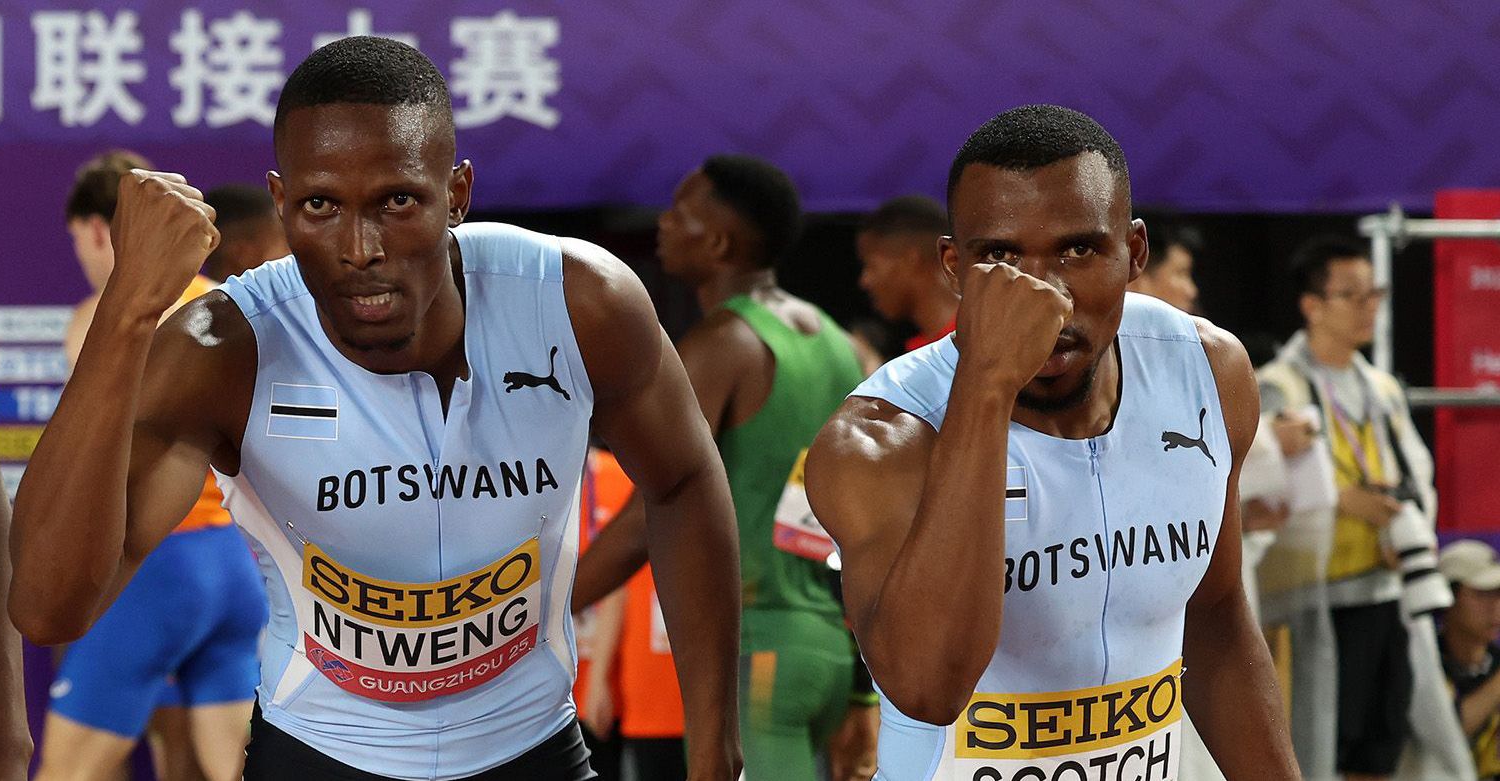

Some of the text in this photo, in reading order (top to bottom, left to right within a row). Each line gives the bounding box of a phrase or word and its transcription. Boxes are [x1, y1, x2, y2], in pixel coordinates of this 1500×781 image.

[317, 457, 559, 511] BOTSWANA
[310, 552, 533, 622] SEIKO
[313, 596, 529, 667] NTWENG
[358, 636, 530, 694] GUANGZHOU 25
[967, 674, 1177, 750] SEIKO
